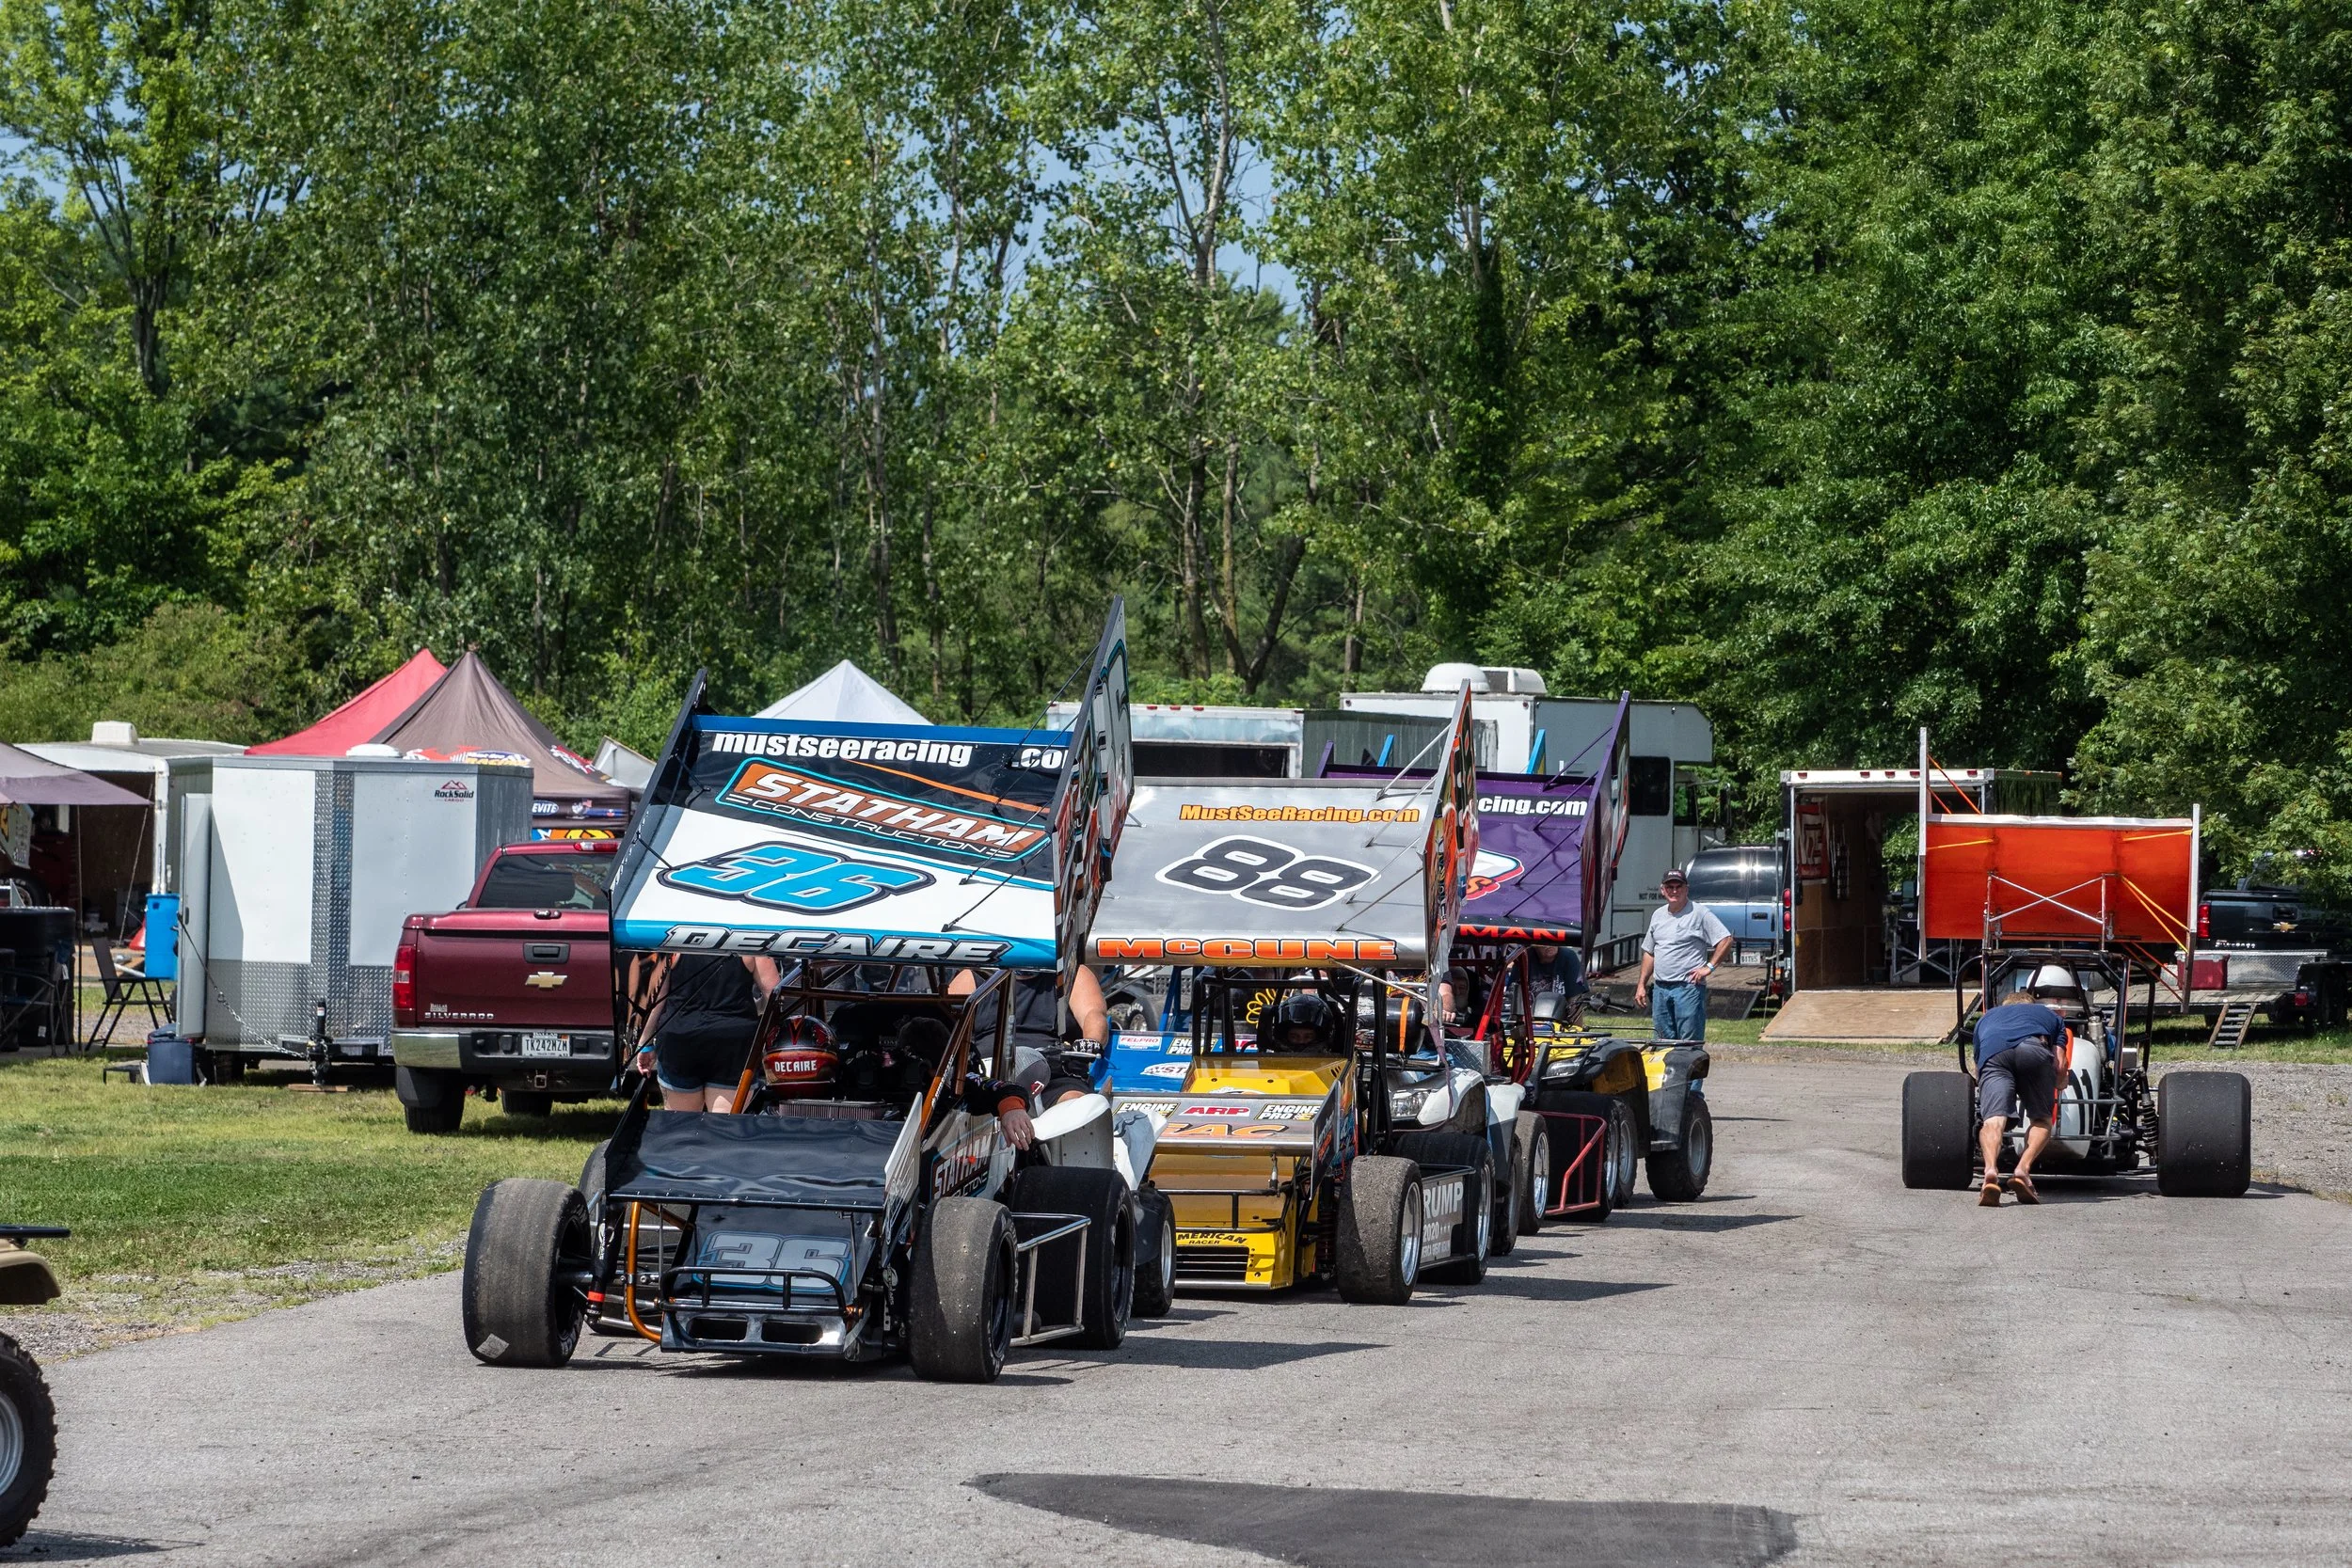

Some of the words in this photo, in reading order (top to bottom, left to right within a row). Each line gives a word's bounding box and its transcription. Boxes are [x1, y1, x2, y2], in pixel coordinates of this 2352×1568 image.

[712, 733, 972, 768] mustseeracing
[1012, 745, 1070, 769] .co
[435, 789, 474, 799] RockSolid
[747, 771, 1035, 847] STATHAM
[1179, 804, 1421, 825] MustSeeRacing.com
[1477, 796, 1588, 816] cing.com
[749, 800, 989, 854] CONSTRUCTION
[661, 843, 934, 914] 36
[1157, 837, 1379, 911] 88
[661, 926, 1011, 962] DECAIRE
[774, 1060, 817, 1072] DECAIRE
[1185, 1106, 1250, 1115] ARP
[1260, 1112, 1291, 1120] PRO
[1263, 1104, 1320, 1114] ENGINE
[934, 1134, 993, 1199] STATHAM
[1422, 1181, 1464, 1219] RUMP
[1177, 1232, 1248, 1243] MERICAN
[1422, 1222, 1439, 1243] 2020
